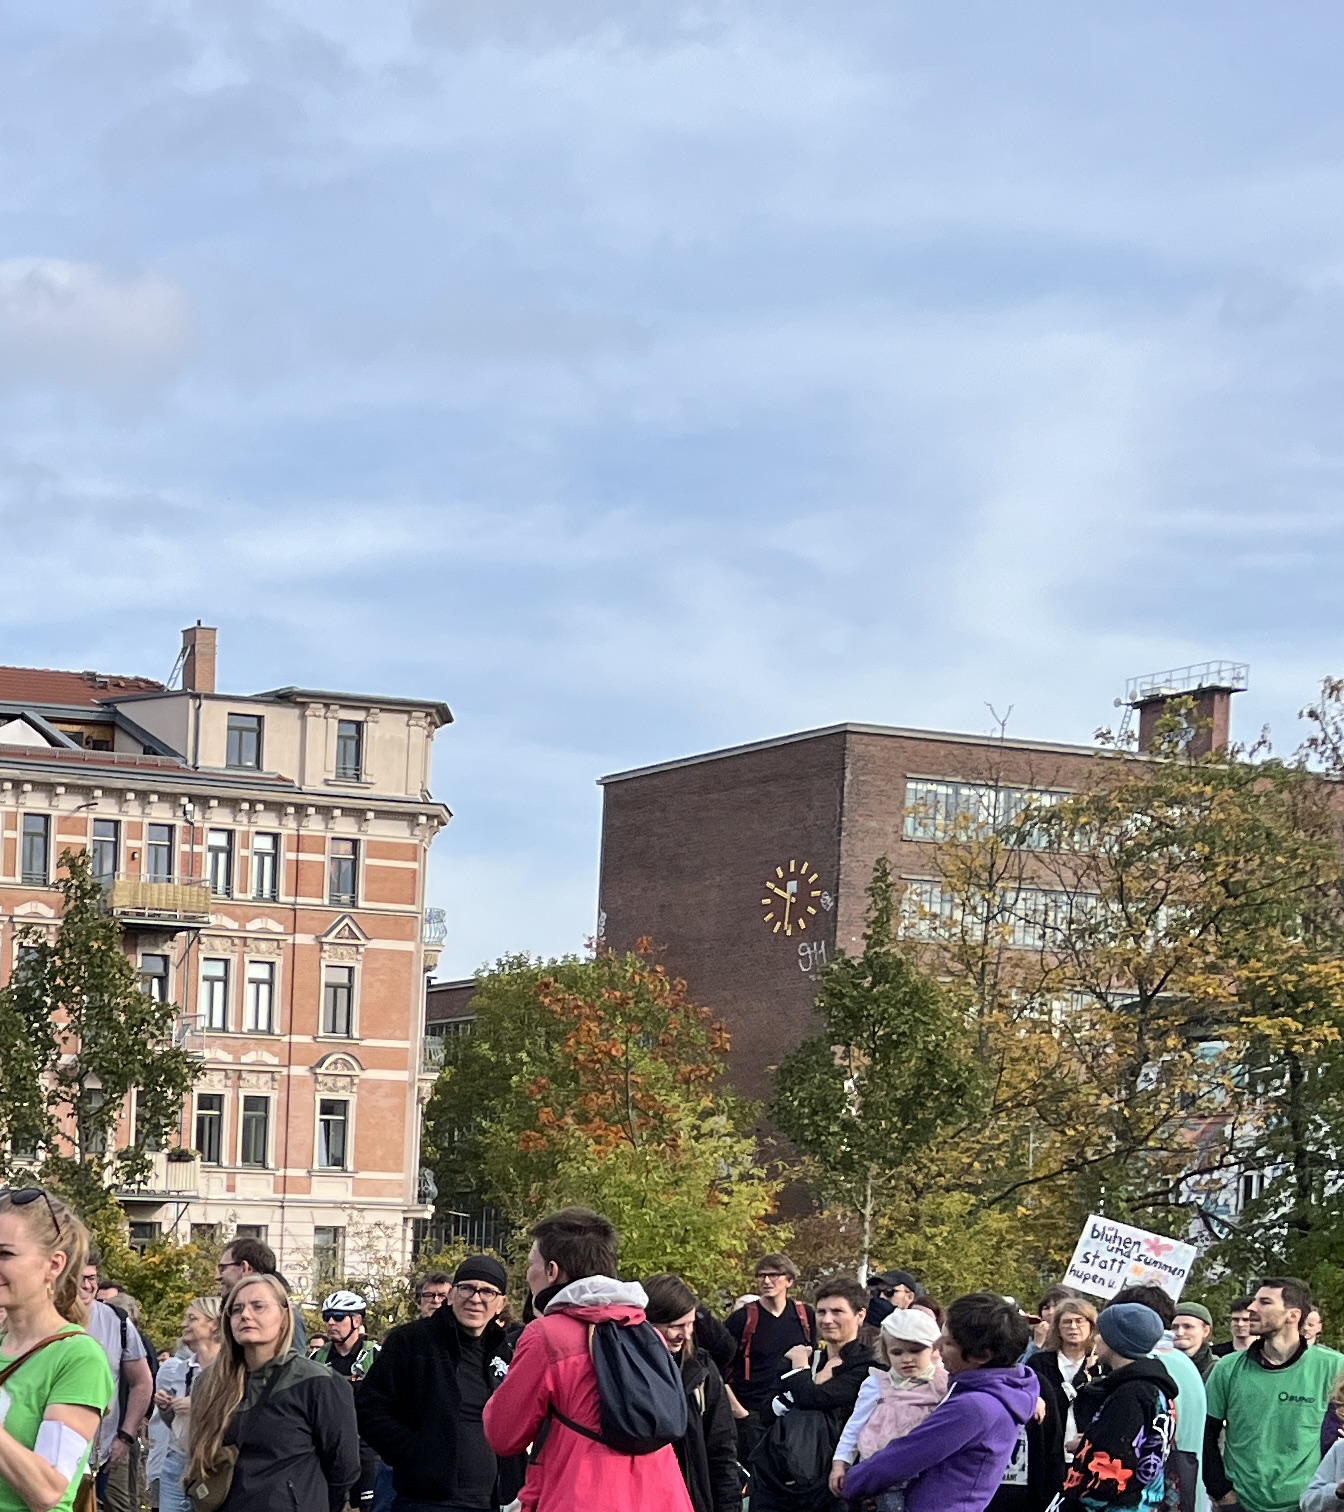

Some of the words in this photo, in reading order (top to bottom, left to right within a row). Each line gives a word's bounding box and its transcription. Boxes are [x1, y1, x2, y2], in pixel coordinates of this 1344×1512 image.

[1091, 1224, 1142, 1251] blühen
[1080, 1250, 1126, 1273] statt
[1106, 1246, 1131, 1259] und
[1133, 1253, 1186, 1278] summen
[1068, 1264, 1105, 1286] hupen
